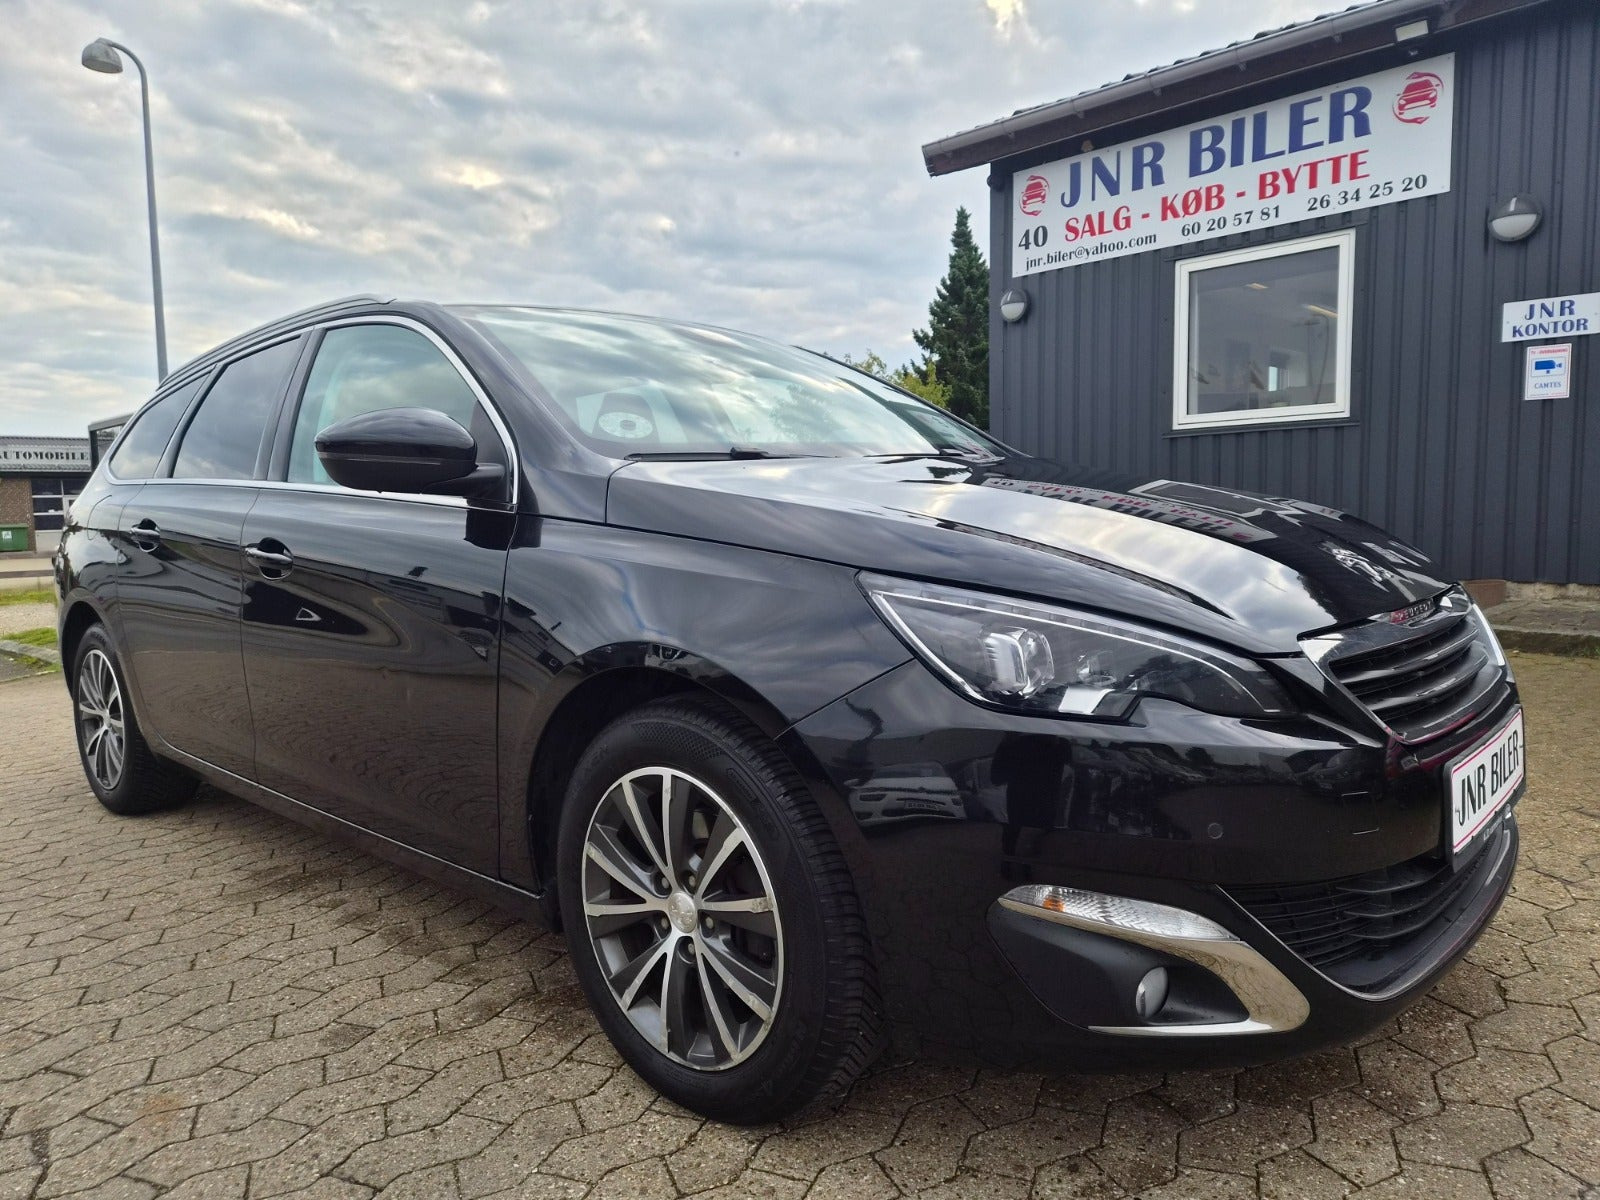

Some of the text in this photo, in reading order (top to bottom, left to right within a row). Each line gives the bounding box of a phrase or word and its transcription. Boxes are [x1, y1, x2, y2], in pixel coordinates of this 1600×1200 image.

[1060, 86, 1372, 209] JNR BILER
[1064, 205, 1132, 243] SALG
[1160, 183, 1226, 222] KØB
[1258, 149, 1371, 201] BYTTE
[1181, 174, 1429, 237] 60 20 57 81 26 34 25 20
[1018, 225, 1049, 250] 40
[1025, 233, 1158, 271] jnr.biler@yahoo.com
[1512, 318, 1589, 337] KONTOR
[1524, 299, 1575, 320] JNR
[0, 451, 88, 461] UTOMOBILE
[1458, 729, 1520, 827] JNR BILER
